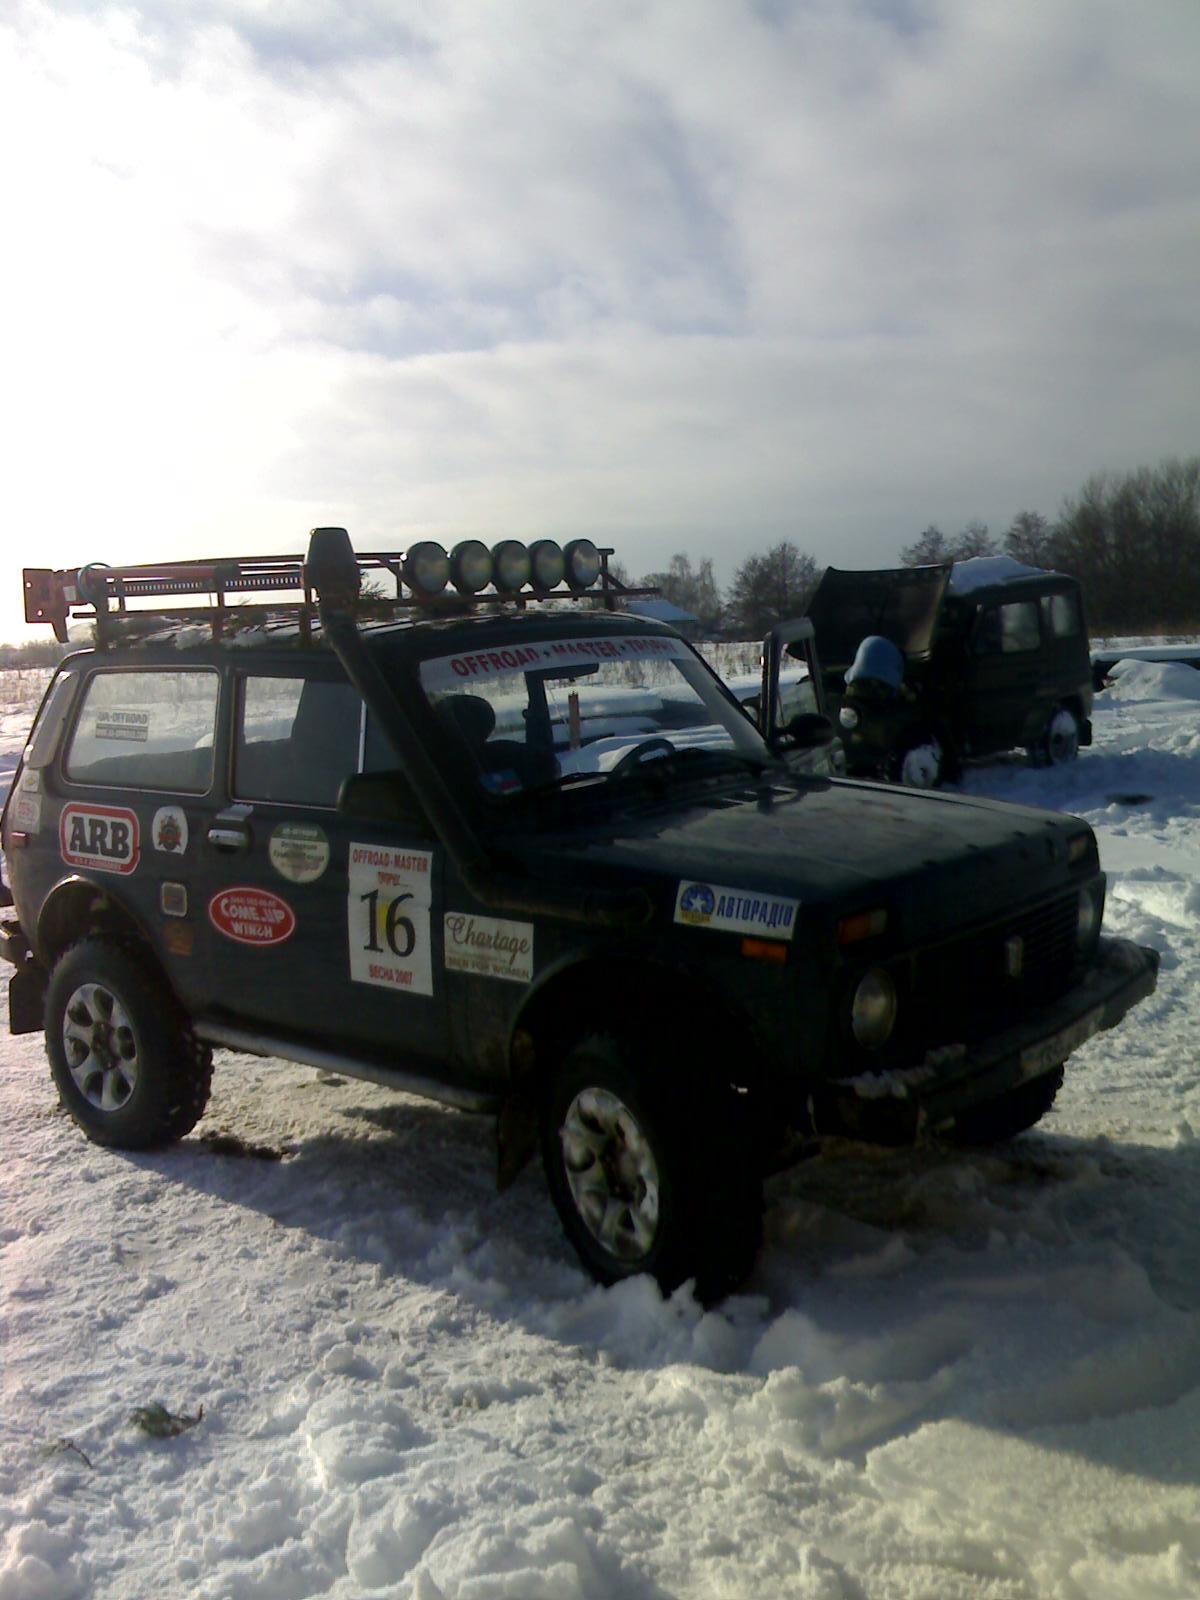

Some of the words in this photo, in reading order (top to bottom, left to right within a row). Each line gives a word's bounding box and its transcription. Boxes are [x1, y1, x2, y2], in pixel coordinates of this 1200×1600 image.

[451, 647, 539, 677] OFFROAD
[70, 816, 130, 858] ARB
[352, 848, 390, 867] OFFROAD
[394, 853, 428, 873] MASTER
[231, 920, 273, 938] WINCH
[361, 888, 416, 958] 16
